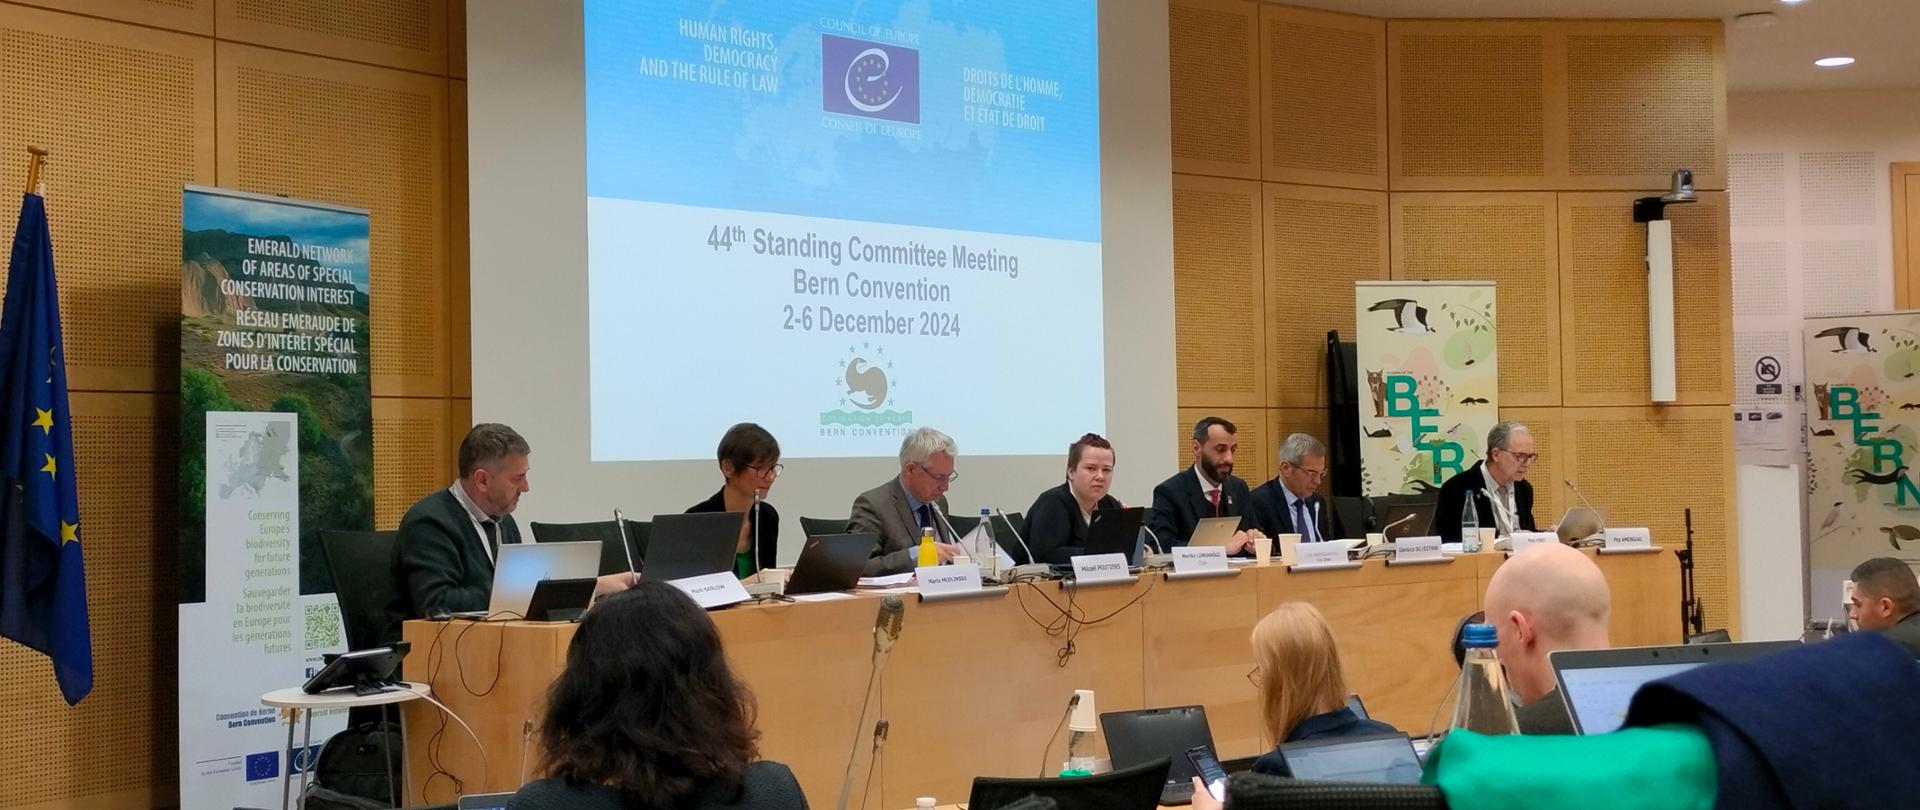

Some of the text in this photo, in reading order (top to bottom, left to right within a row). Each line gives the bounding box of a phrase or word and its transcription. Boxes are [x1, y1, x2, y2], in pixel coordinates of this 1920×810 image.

[679, 18, 777, 53] HUMAN RIGHTS,
[819, 16, 920, 44] COUNCIL OF EUROPE
[704, 44, 778, 73] DEMOCRACY
[640, 57, 778, 93] AND THE RULE OF LAW
[963, 66, 999, 87] DROITS
[1001, 73, 1013, 90] DE
[964, 105, 974, 121] ET
[1002, 111, 1015, 128] DE
[1017, 113, 1045, 132] DROIT
[248, 238, 354, 264] EMERALD NETWORK
[707, 225, 1018, 279] 44th Standing Committee Meeting
[242, 259, 354, 285] OF AREAS OF SPECIAL
[221, 279, 355, 305] CONSERVATION INTEREST
[794, 268, 950, 302] Bern Convention
[236, 308, 356, 333] RÉSEAU EMERAUDE DE
[783, 304, 961, 337] 2-6 December 2024
[217, 330, 254, 349] ZONES
[314, 334, 357, 354] SPÉCIAL
[226, 353, 357, 374] POUR LA CONSERVATION
[820, 428, 845, 436] BERN
[248, 510, 290, 522] Conserving
[246, 538, 290, 550] biodiversity
[254, 551, 291, 563] for future
[245, 567, 290, 580] generations
[242, 586, 291, 600] Sauvegarder
[236, 602, 244, 613] la
[233, 615, 291, 628] en Europe pour
[232, 632, 243, 642] les
[264, 644, 291, 655] futures
[216, 710, 249, 720] Convention
[243, 716, 276, 726] Convention
